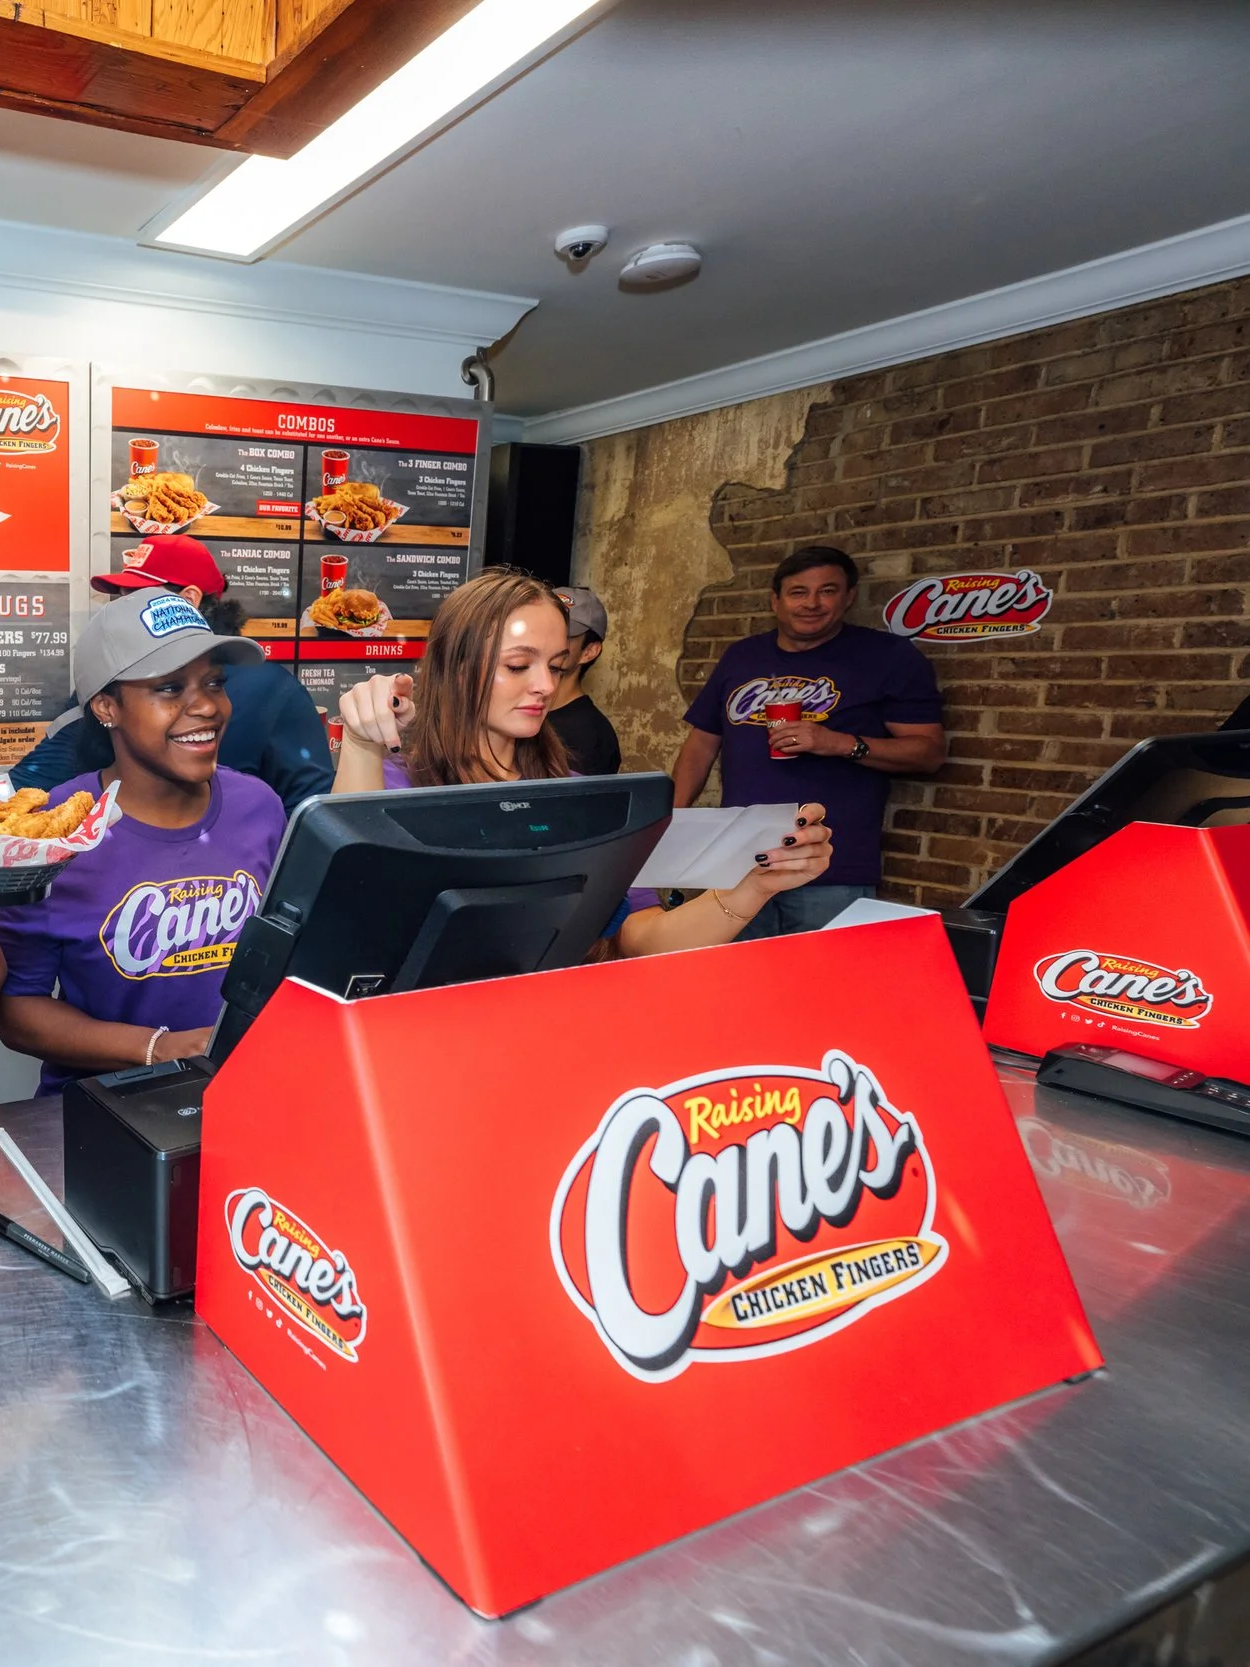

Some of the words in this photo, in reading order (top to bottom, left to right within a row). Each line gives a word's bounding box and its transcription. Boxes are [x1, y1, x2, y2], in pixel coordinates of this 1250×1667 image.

[278, 414, 335, 433] COMBOS
[19, 440, 47, 450] FINGERS
[249, 448, 265, 457] BOX
[267, 449, 295, 459] COMBO
[240, 464, 245, 472] 4
[246, 464, 270, 473] Chicken
[271, 466, 294, 476] Fingers
[415, 460, 441, 469] FINGER
[443, 462, 467, 471] COMBO
[424, 476, 445, 484] Chicken
[446, 478, 466, 486] Fingers
[271, 505, 298, 513] FAVORITE
[232, 549, 262, 558] CANIAC
[263, 550, 291, 559] COMBO
[396, 555, 435, 563] SANDWICH
[437, 556, 460, 564] COMBO
[243, 565, 266, 573] Chicken
[267, 566, 290, 575] Fingers
[946, 577, 1000, 593] Raising
[890, 571, 1050, 637] Cane's
[937, 626, 978, 635] CHICKEN
[982, 624, 1025, 633] FINGERS
[31, 631, 67, 644] $77.99
[12, 649, 36, 658] Fingers
[365, 645, 403, 656] DRINKS
[301, 669, 322, 677] FRESH
[323, 669, 335, 677] TEA
[365, 666, 376, 674] Tea
[306, 678, 335, 686] LEMONADE
[169, 884, 223, 904] Raising
[173, 950, 218, 964] CHICKEN
[1102, 958, 1159, 978] Raising
[1041, 951, 1209, 1008] Cane's
[1090, 998, 1133, 1013] CHICKEN
[1137, 1009, 1183, 1025] FINGERS
[1112, 1025, 1160, 1041] RaisingCanes
[684, 1083, 802, 1144] Raising
[585, 1058, 917, 1368] Cane's
[273, 1210, 320, 1258] Raising
[24, 1233, 50, 1252] PERMANENT
[231, 1190, 362, 1319] Cane's
[731, 1272, 829, 1323] CHICKEN
[831, 1243, 921, 1290] FINGERS
[268, 1275, 303, 1313] CHICKEN
[305, 1309, 344, 1349] FINGERS
